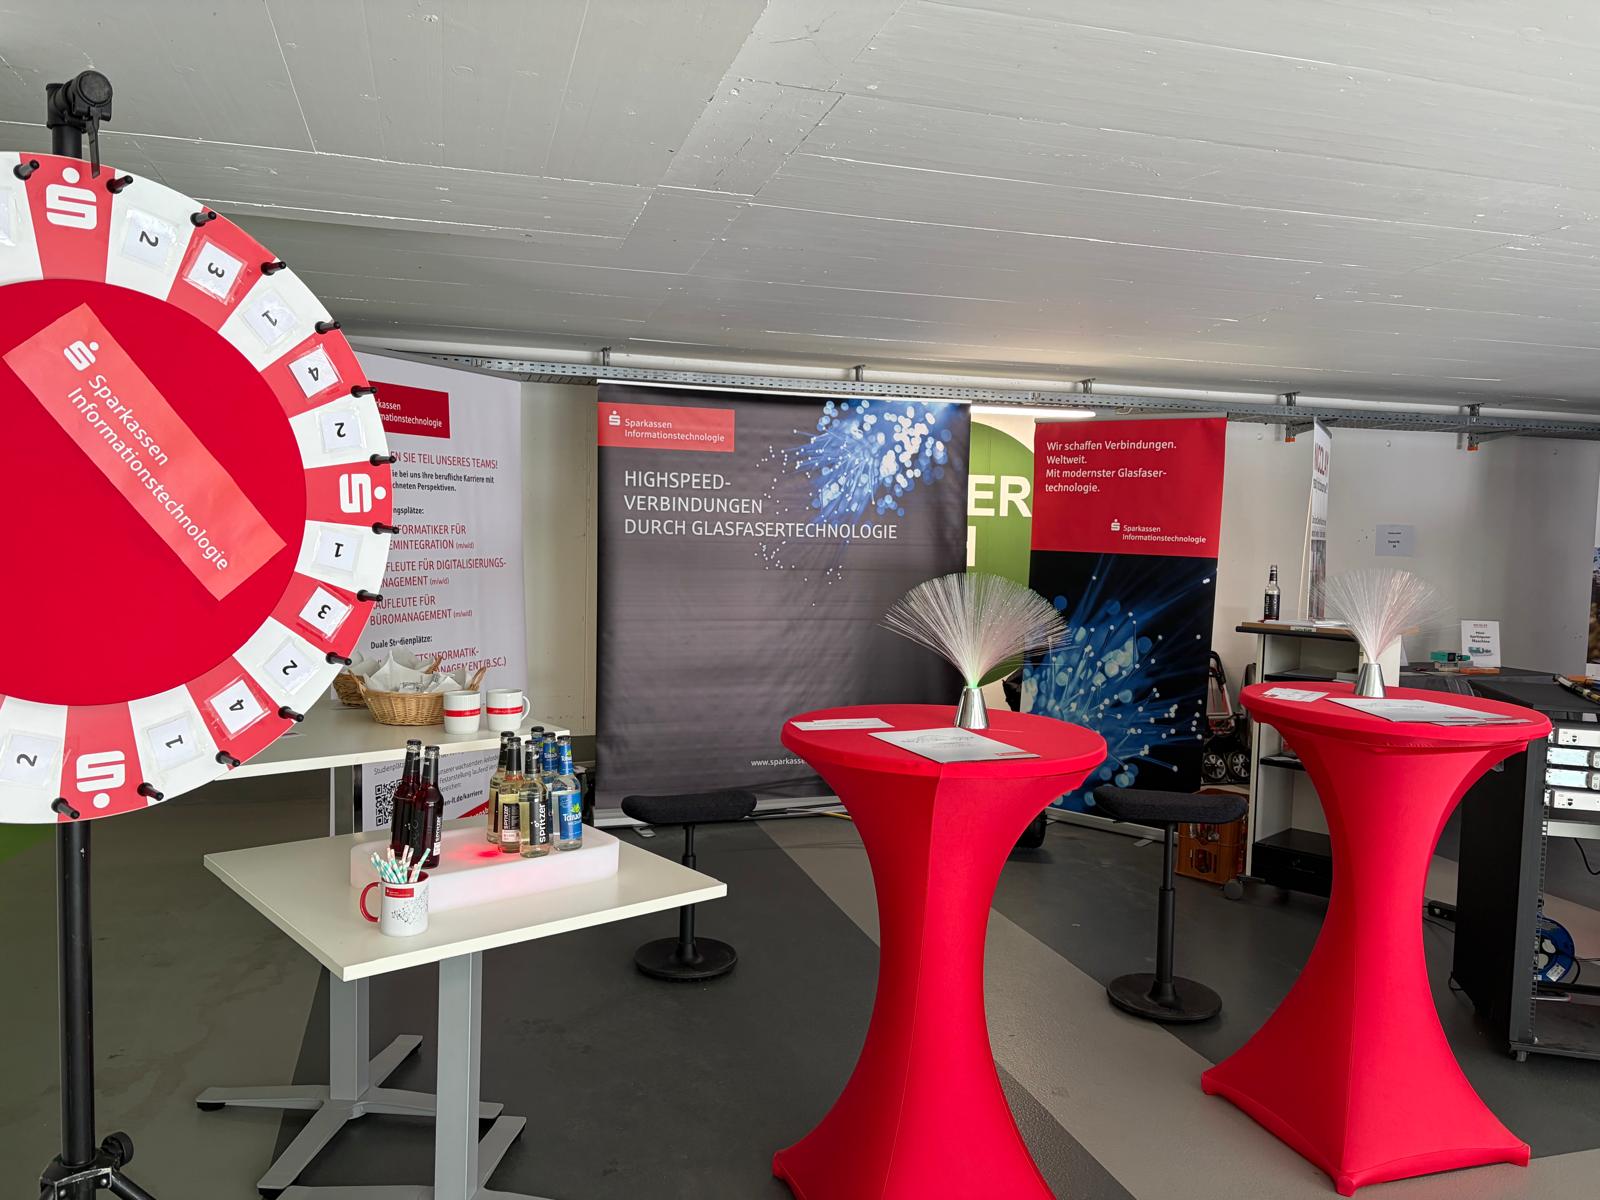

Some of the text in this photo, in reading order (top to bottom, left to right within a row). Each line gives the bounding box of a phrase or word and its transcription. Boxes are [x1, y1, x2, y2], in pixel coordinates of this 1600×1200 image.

[139, 230, 159, 248] 2
[207, 261, 225, 279] 3
[261, 309, 278, 328] 1
[308, 365, 320, 382] 4
[88, 374, 168, 466] Sparkassen
[624, 418, 672, 429] Sparkassen
[334, 422, 346, 438] 2
[624, 430, 726, 444] Informationstechnologie
[1046, 439, 1177, 452] Wir schaffen Verbindungen.
[403, 452, 416, 463] SIE
[418, 453, 434, 465] TEIL
[436, 455, 471, 467] UNSERES
[472, 458, 498, 470] TEAMS!
[1046, 455, 1088, 464] Weltweit.
[68, 387, 228, 570] Informationstechnologie
[399, 470, 409, 478] bei
[422, 471, 434, 480] Ihre
[434, 472, 463, 482] berufliche
[464, 474, 485, 483] Karriere
[485, 476, 494, 484] mit
[624, 470, 731, 490] HIGHSPEED-
[1045, 468, 1167, 478] Mit modernster Glasfaser-
[417, 482, 457, 492] Perspektiven.
[1045, 482, 1100, 494] technologie.
[967, 474, 1032, 518] ER
[624, 494, 763, 514] VERBINDUNGEN
[451, 523, 467, 535] FÜR
[624, 518, 898, 539] DURCH GLASFASERTECHNOLOGIE
[1123, 524, 1161, 533] Sparkassen
[1122, 534, 1207, 544] Informationstechnologie
[334, 542, 344, 558] 1
[418, 558, 435, 571] FÜR
[436, 557, 507, 570] DIGITALISIERUNGS-
[381, 576, 428, 588] NAGEMENT
[420, 595, 436, 606] FÜR
[317, 604, 332, 619] 3
[370, 608, 452, 626] BÜROMANAGEMENT
[370, 640, 388, 650] Duale
[282, 660, 298, 676] 2
[228, 699, 244, 714] 4
[164, 734, 184, 749] 1
[16, 752, 38, 767] 2
